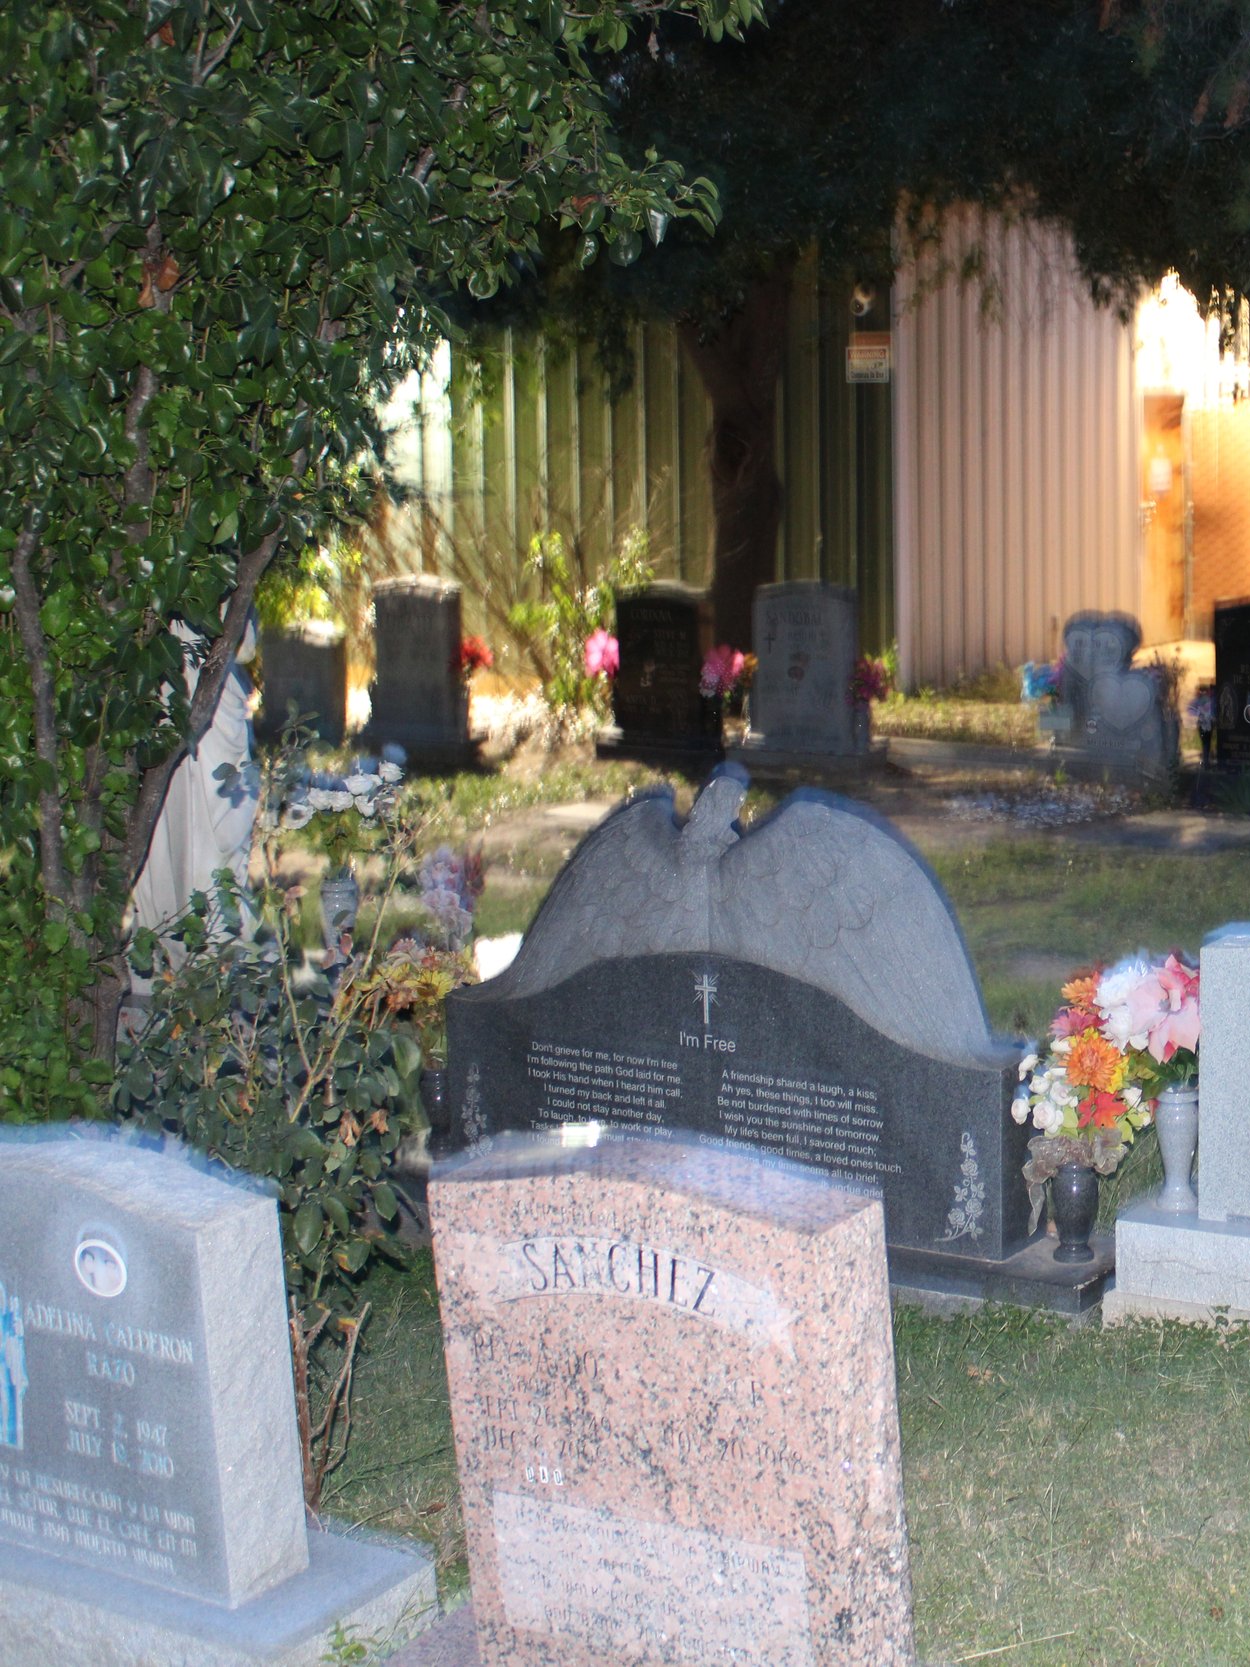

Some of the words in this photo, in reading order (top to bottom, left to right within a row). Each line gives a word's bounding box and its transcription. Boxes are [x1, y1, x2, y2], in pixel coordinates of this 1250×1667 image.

[849, 351, 885, 359] WARNING
[531, 1041, 553, 1053] Don't
[555, 1046, 580, 1057] grieve
[581, 1048, 593, 1058] for
[613, 1052, 625, 1062] for
[627, 1057, 645, 1065] now
[646, 1057, 659, 1068] I'm
[661, 1059, 678, 1070] free
[679, 1031, 699, 1049] I'm
[704, 1034, 736, 1053] Free
[527, 1054, 539, 1064] I'm
[540, 1056, 578, 1072] following
[579, 1062, 593, 1072] the
[594, 1065, 614, 1075] path
[615, 1066, 634, 1078] God
[635, 1069, 652, 1080] laid
[653, 1072, 665, 1081] for
[533, 1068, 551, 1079] took
[552, 1070, 567, 1081] His
[568, 1073, 590, 1085] hand
[591, 1077, 615, 1088] when
[621, 1080, 646, 1093] heard
[647, 1085, 664, 1095] him
[548, 1084, 576, 1095] turned
[577, 1089, 591, 1100] my
[592, 1090, 613, 1102] back
[614, 1094, 631, 1104] and
[632, 1096, 646, 1106] left
[721, 1069, 729, 1079] A
[731, 1070, 774, 1087] friendship
[776, 1077, 807, 1090] shared
[817, 1082, 846, 1097] laugh,
[552, 1098, 575, 1110] could
[577, 1102, 592, 1112] not
[592, 1104, 610, 1116] stay
[611, 1107, 644, 1119] another
[721, 1083, 734, 1093] Ah
[735, 1087, 754, 1097] yes,
[756, 1088, 780, 1100] these
[820, 1097, 835, 1108] too
[837, 1099, 852, 1110] will
[538, 1107, 550, 1118] To
[610, 1120, 619, 1129] to
[621, 1122, 641, 1132] work
[643, 1125, 652, 1134] or
[717, 1096, 730, 1107] Be
[731, 1099, 746, 1109] not
[748, 1100, 791, 1116] burdened
[793, 1108, 812, 1118] with
[814, 1110, 839, 1122] times
[840, 1114, 850, 1123] of
[852, 1117, 884, 1129] sorrow
[724, 1112, 744, 1122] wish
[746, 1116, 763, 1126] you
[765, 1117, 780, 1127] the
[781, 1120, 822, 1134] sunshine
[824, 1126, 833, 1135] of
[724, 1124, 738, 1136] My
[740, 1126, 759, 1139] life's
[761, 1130, 784, 1142] been
[809, 1138, 846, 1152] savored
[699, 1134, 724, 1146] Good
[760, 1145, 784, 1156] good
[823, 1153, 848, 1165] loved
[850, 1159, 873, 1170] ones
[762, 1159, 776, 1168] my
[777, 1160, 797, 1171] time
[800, 1164, 829, 1176] seems
[831, 1168, 842, 1178] all
[844, 1171, 853, 1180] to
[522, 1243, 720, 1317] SANCHEZ
[25, 1302, 97, 1342] ADELINA
[106, 1322, 194, 1364] CALDERON
[87, 1351, 135, 1388] RAZO
[67, 1429, 102, 1458] JULY
[163, 1509, 196, 1534] VIDA
